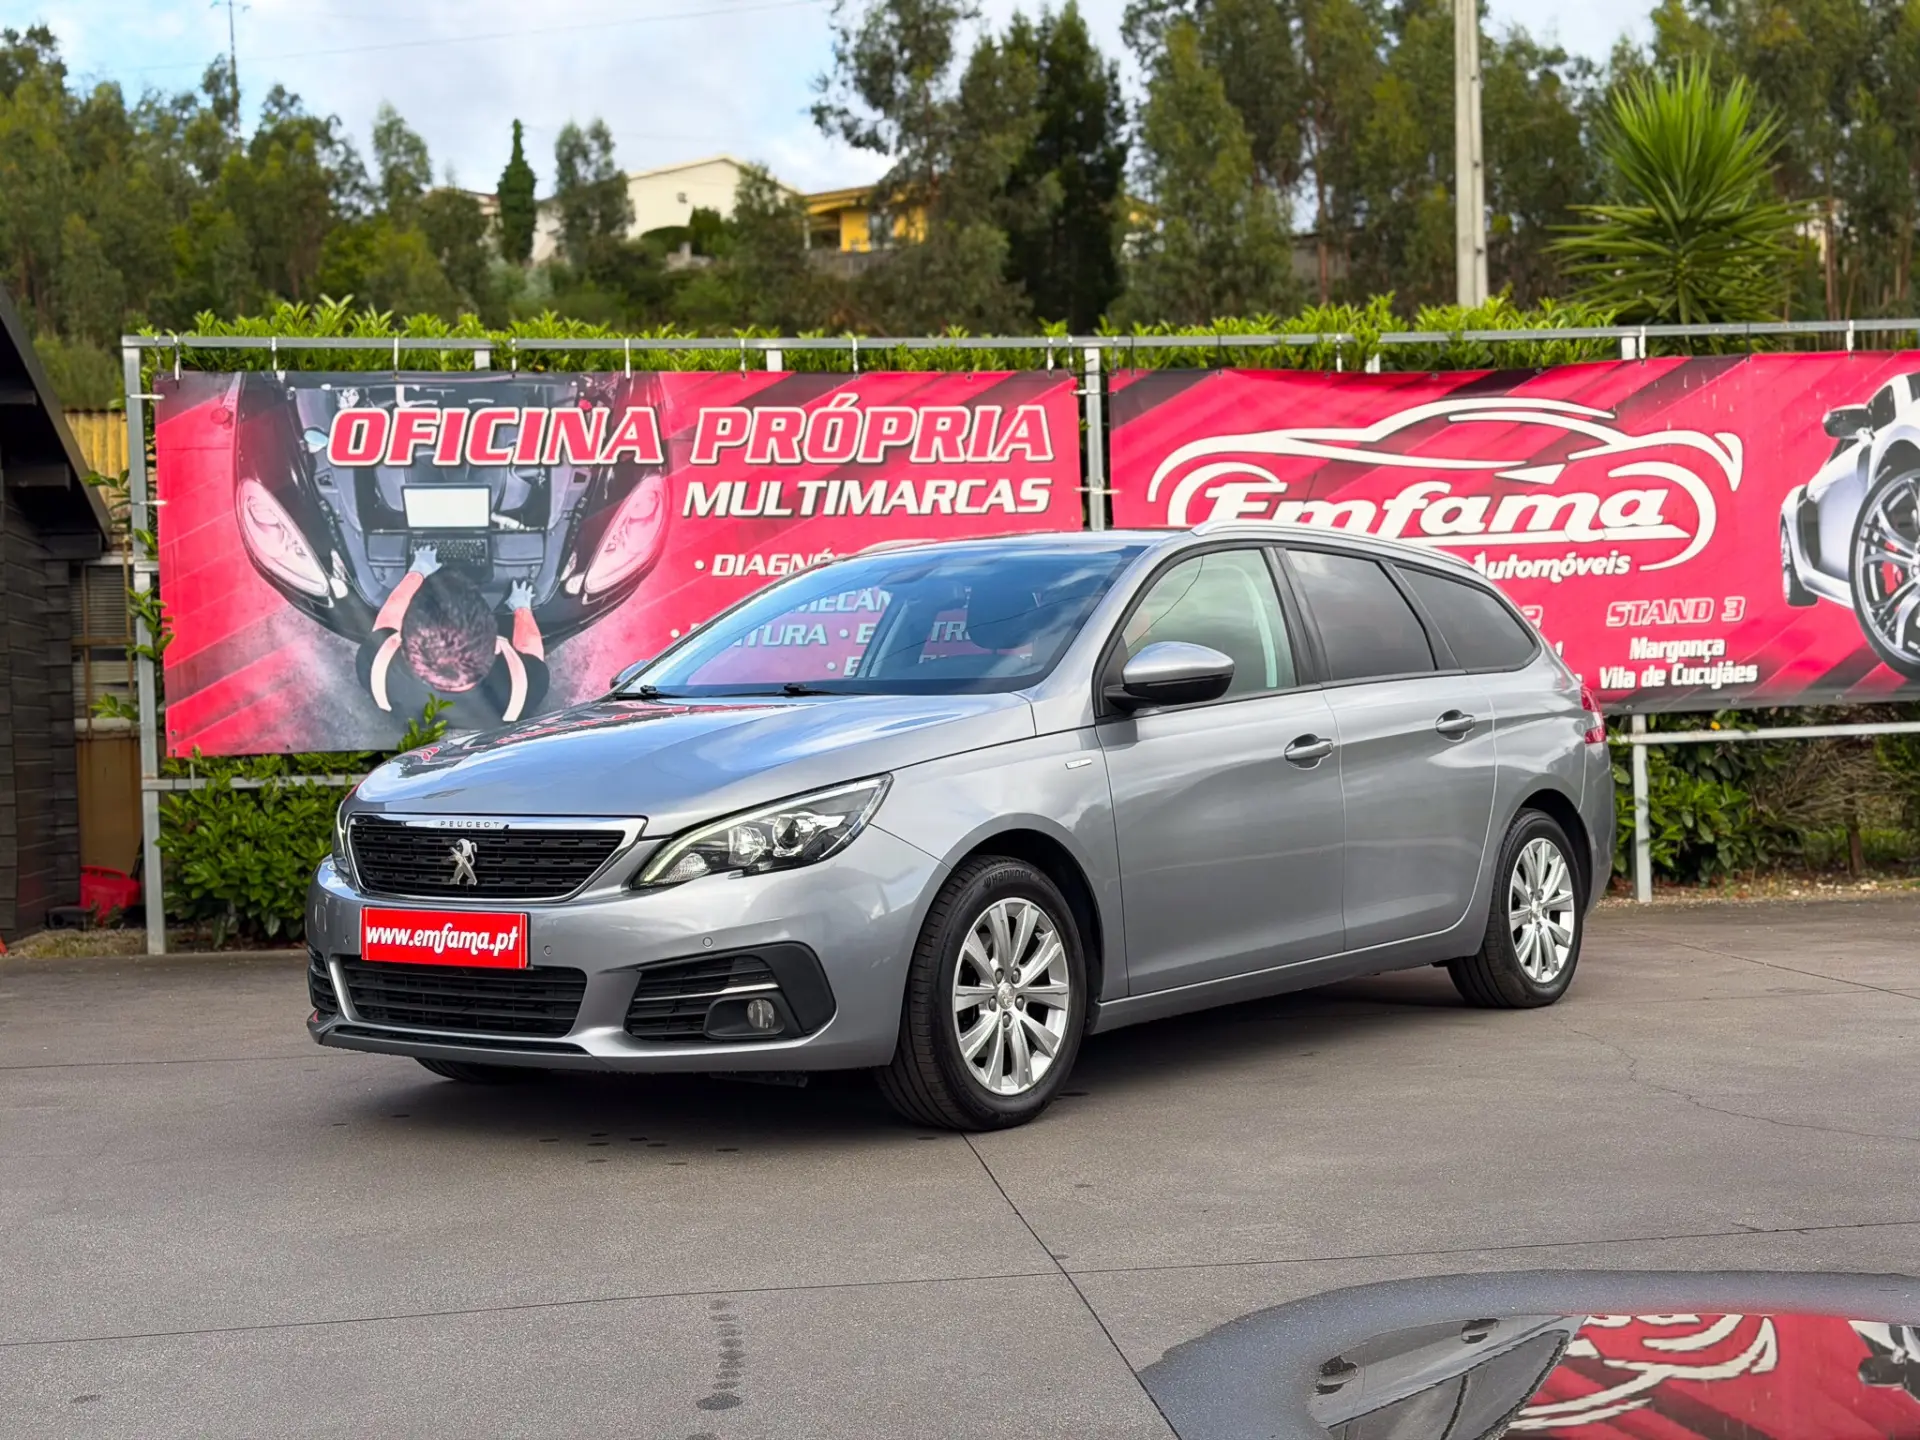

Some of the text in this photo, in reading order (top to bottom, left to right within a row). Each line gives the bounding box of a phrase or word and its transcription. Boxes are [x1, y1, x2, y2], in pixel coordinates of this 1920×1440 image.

[327, 392, 1055, 466] OFICINA PRÓPRIA
[682, 477, 1053, 517] MULTIMARCAS
[1204, 480, 1669, 543] Emfama
[1606, 595, 1747, 627] STAND 3
[1629, 636, 1726, 664] Margonça
[1599, 661, 1759, 690] Vila de Cucujães
[440, 820, 500, 828] PEUGEOT
[366, 922, 519, 957] www.emfama.pt
